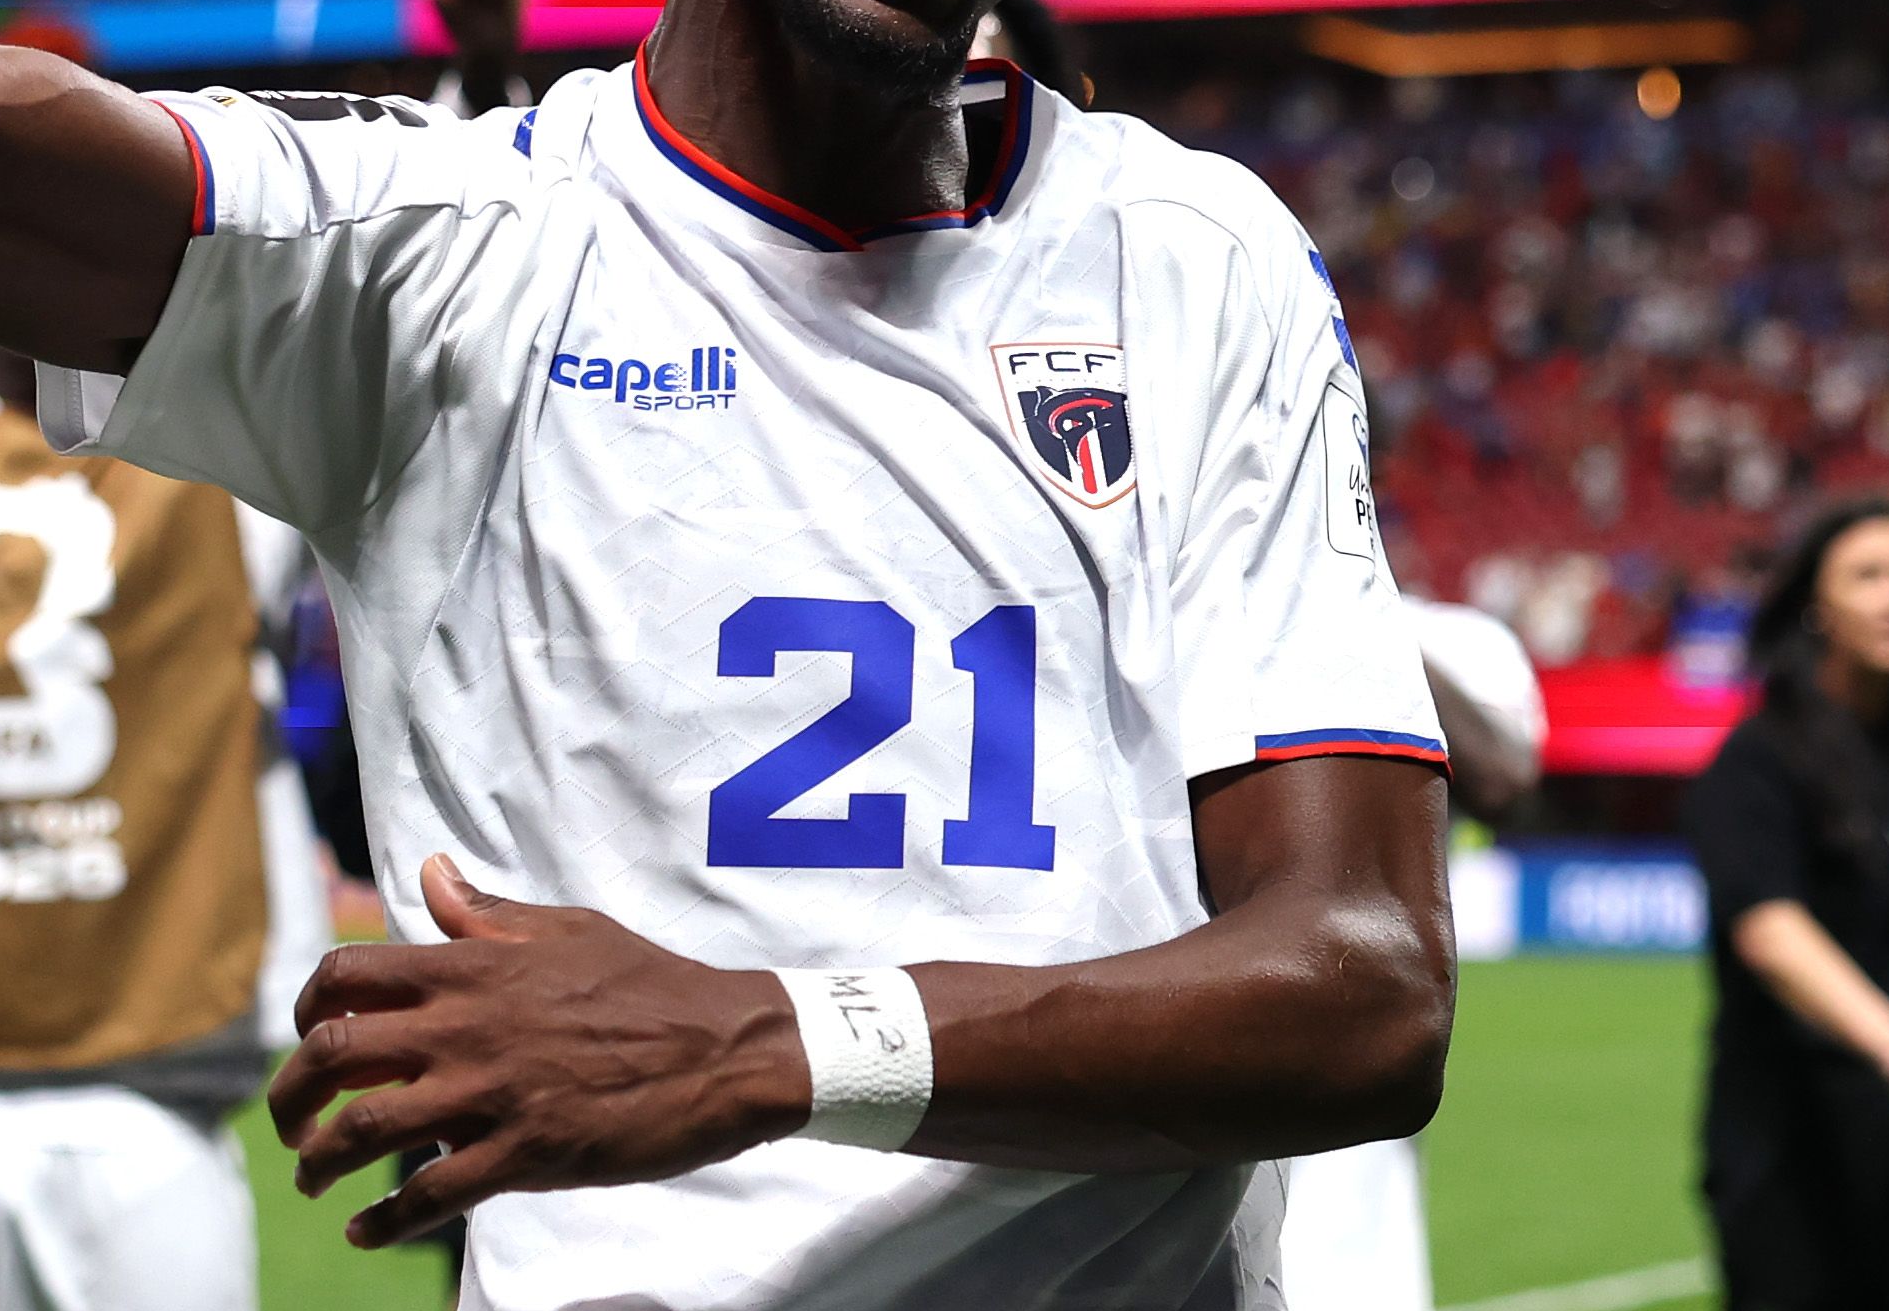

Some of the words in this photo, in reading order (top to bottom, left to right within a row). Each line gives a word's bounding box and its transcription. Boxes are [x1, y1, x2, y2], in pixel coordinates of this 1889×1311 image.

[549, 346, 736, 403] capelli
[1009, 351, 1116, 375] FCF
[633, 394, 737, 411] SPORT
[707, 596, 1056, 872] 21
